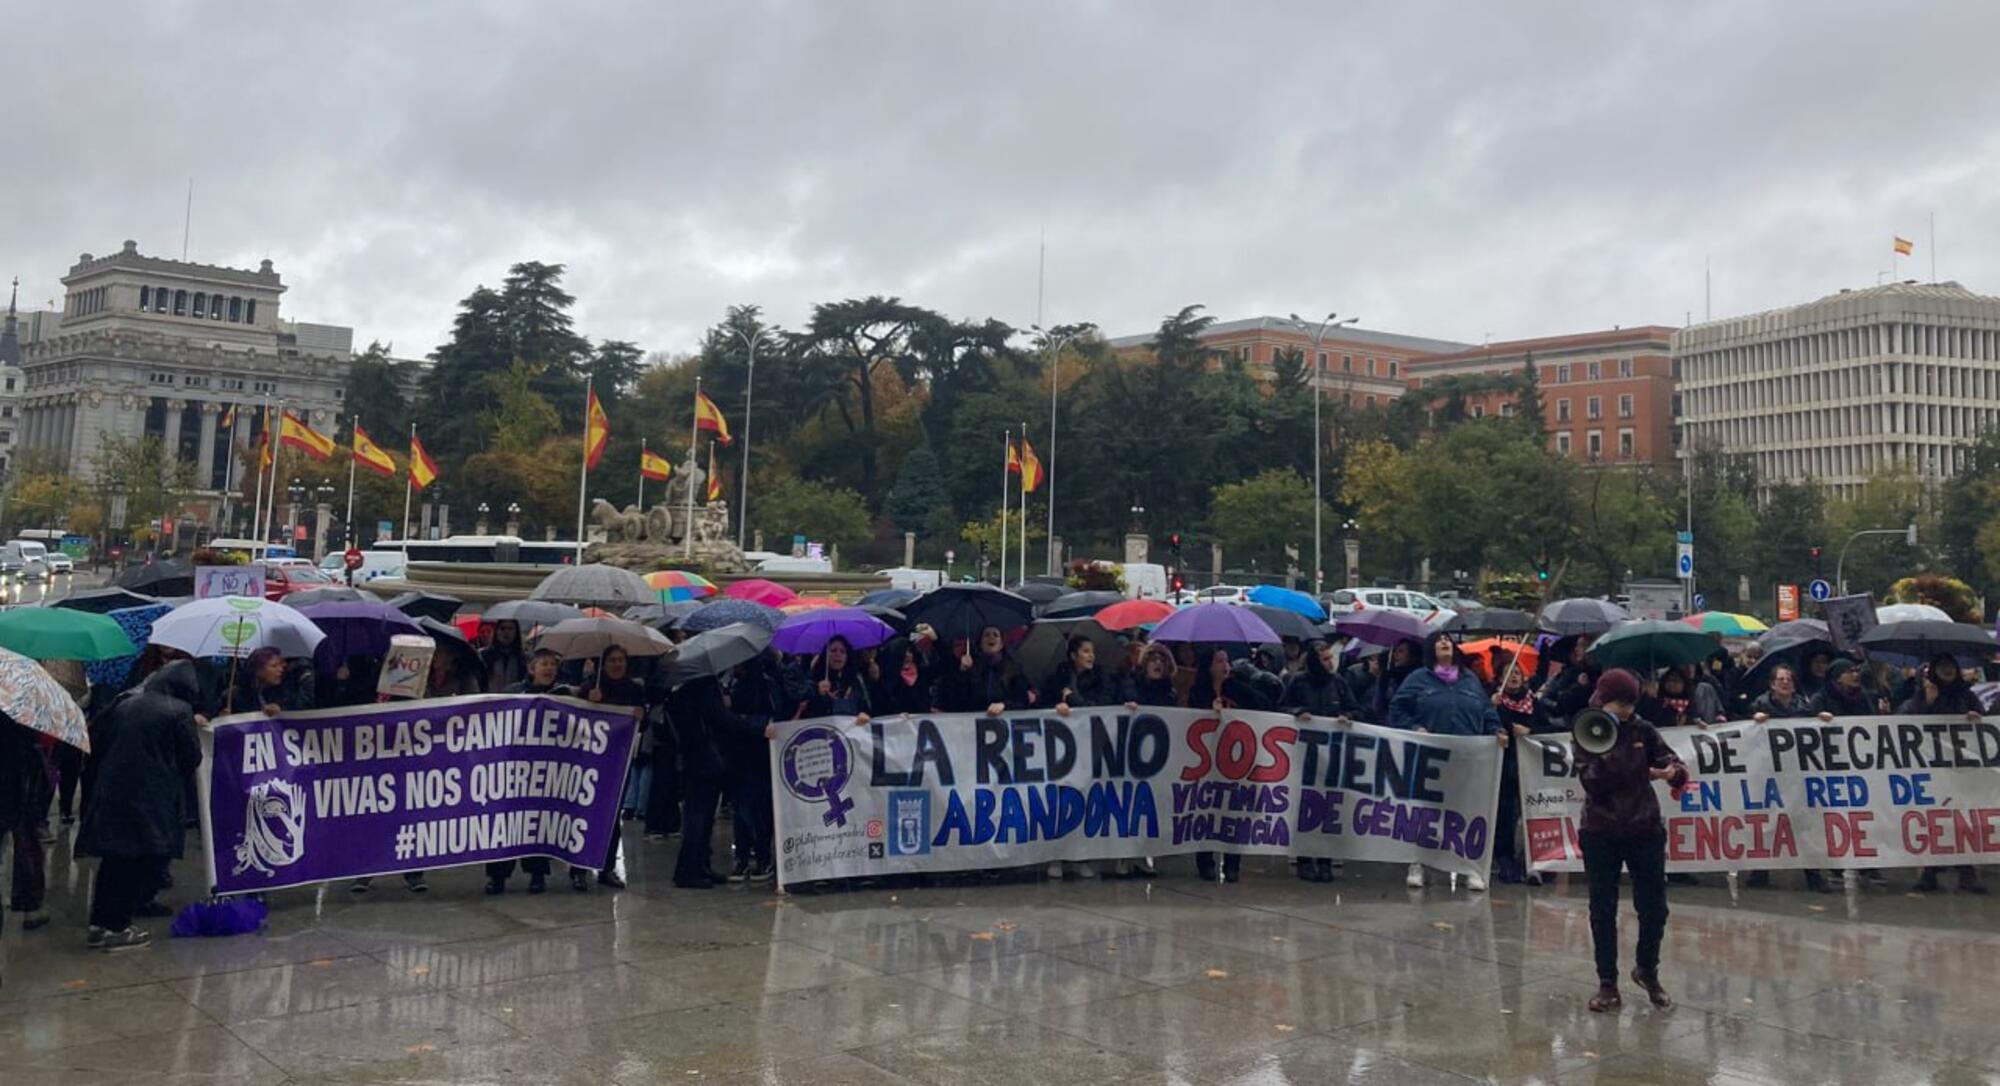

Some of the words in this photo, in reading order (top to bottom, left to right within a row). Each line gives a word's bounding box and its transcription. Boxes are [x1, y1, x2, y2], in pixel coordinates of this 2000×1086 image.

[242, 733, 277, 774] EN
[284, 727, 344, 767] SAN
[354, 708, 611, 761] BLAS-CANILLEJAS
[870, 719, 956, 787] LA
[974, 717, 1077, 784] RED
[1090, 714, 1170, 778] NO
[1690, 730, 1746, 774] DE
[1768, 723, 2000, 775] PRECARIED
[313, 773, 396, 818] VIVAS
[405, 768, 461, 810] NOS
[470, 761, 599, 807] QUEREMOS
[931, 780, 1159, 846] ABANDONA
[1680, 779, 1722, 812] EN
[1740, 777, 1784, 810] LA
[1805, 775, 1869, 808] RED
[1888, 773, 1935, 805] DE
[395, 811, 588, 860] #NIUNAMENOS
[1298, 788, 1344, 835] DE
[1352, 796, 1487, 860] GÉNERO
[1823, 811, 1878, 858] DE
[1901, 797, 2000, 855] GÉNE
